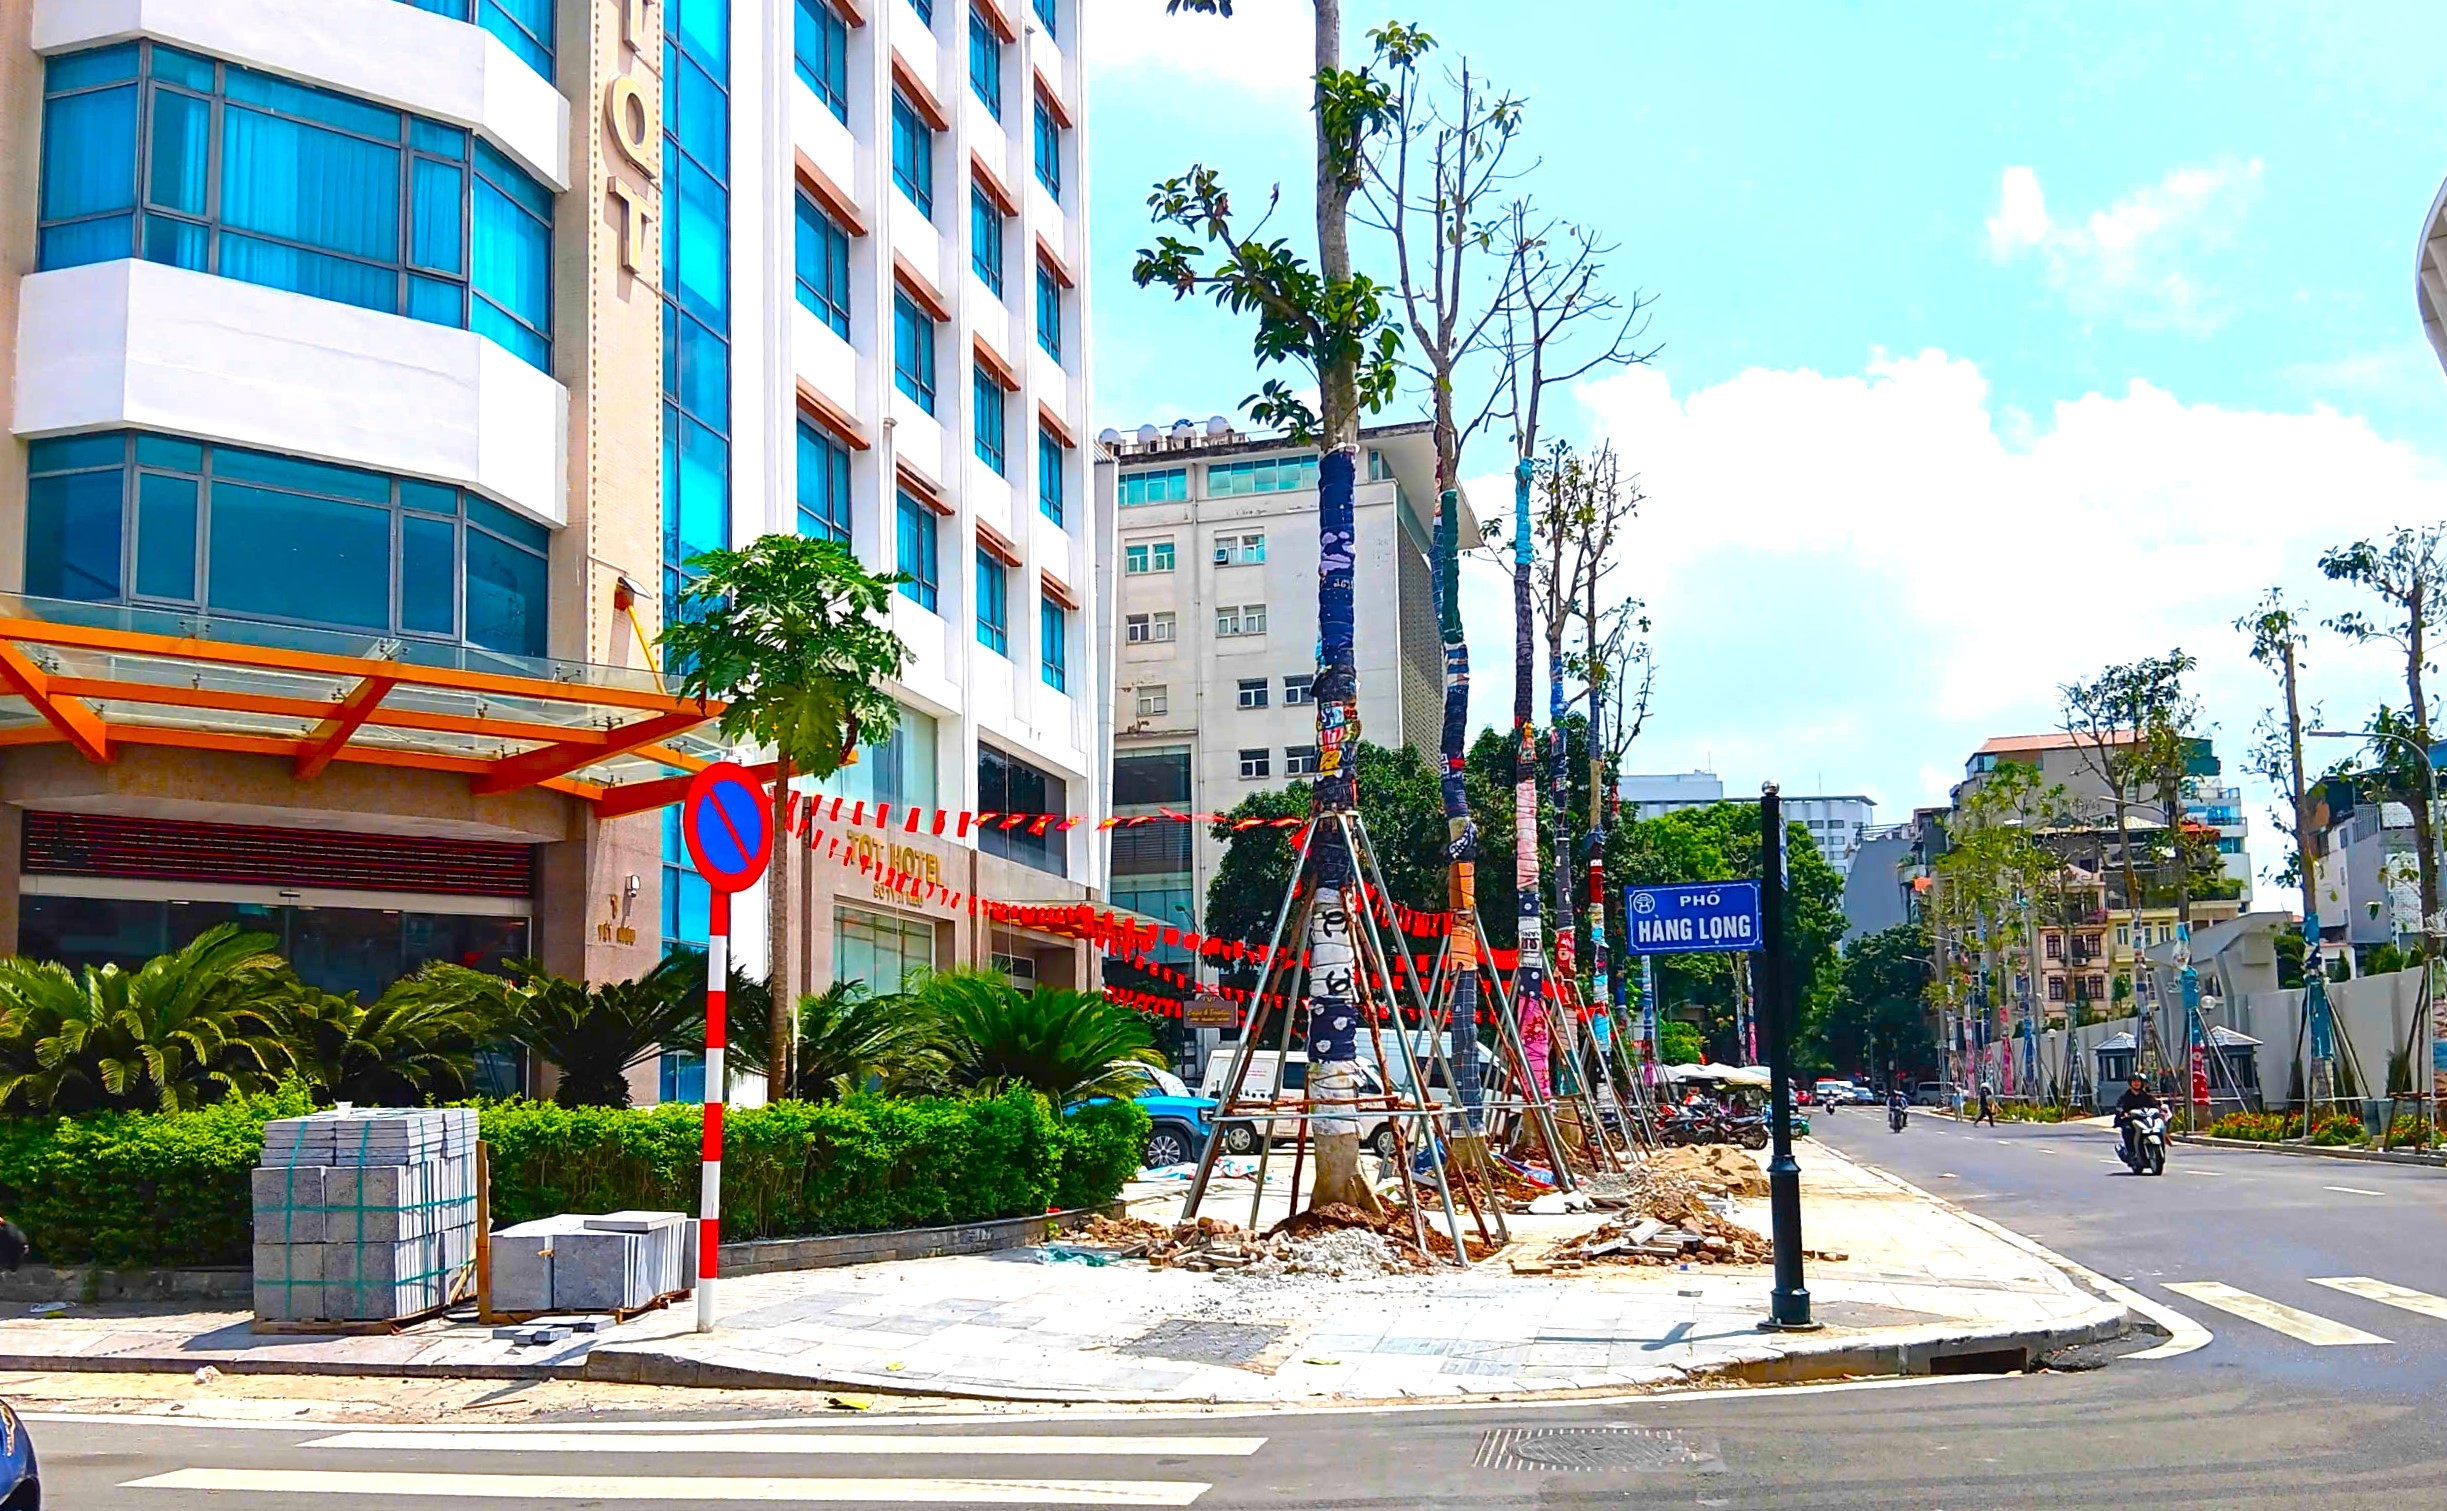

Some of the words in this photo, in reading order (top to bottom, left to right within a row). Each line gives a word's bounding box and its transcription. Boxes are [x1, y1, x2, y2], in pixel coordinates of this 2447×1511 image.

[889, 843, 944, 888] HOTEL
[1679, 888, 1722, 907] PHỐ
[1638, 914, 1692, 943] HÀNG
[1699, 914, 1750, 944] LỌNG
